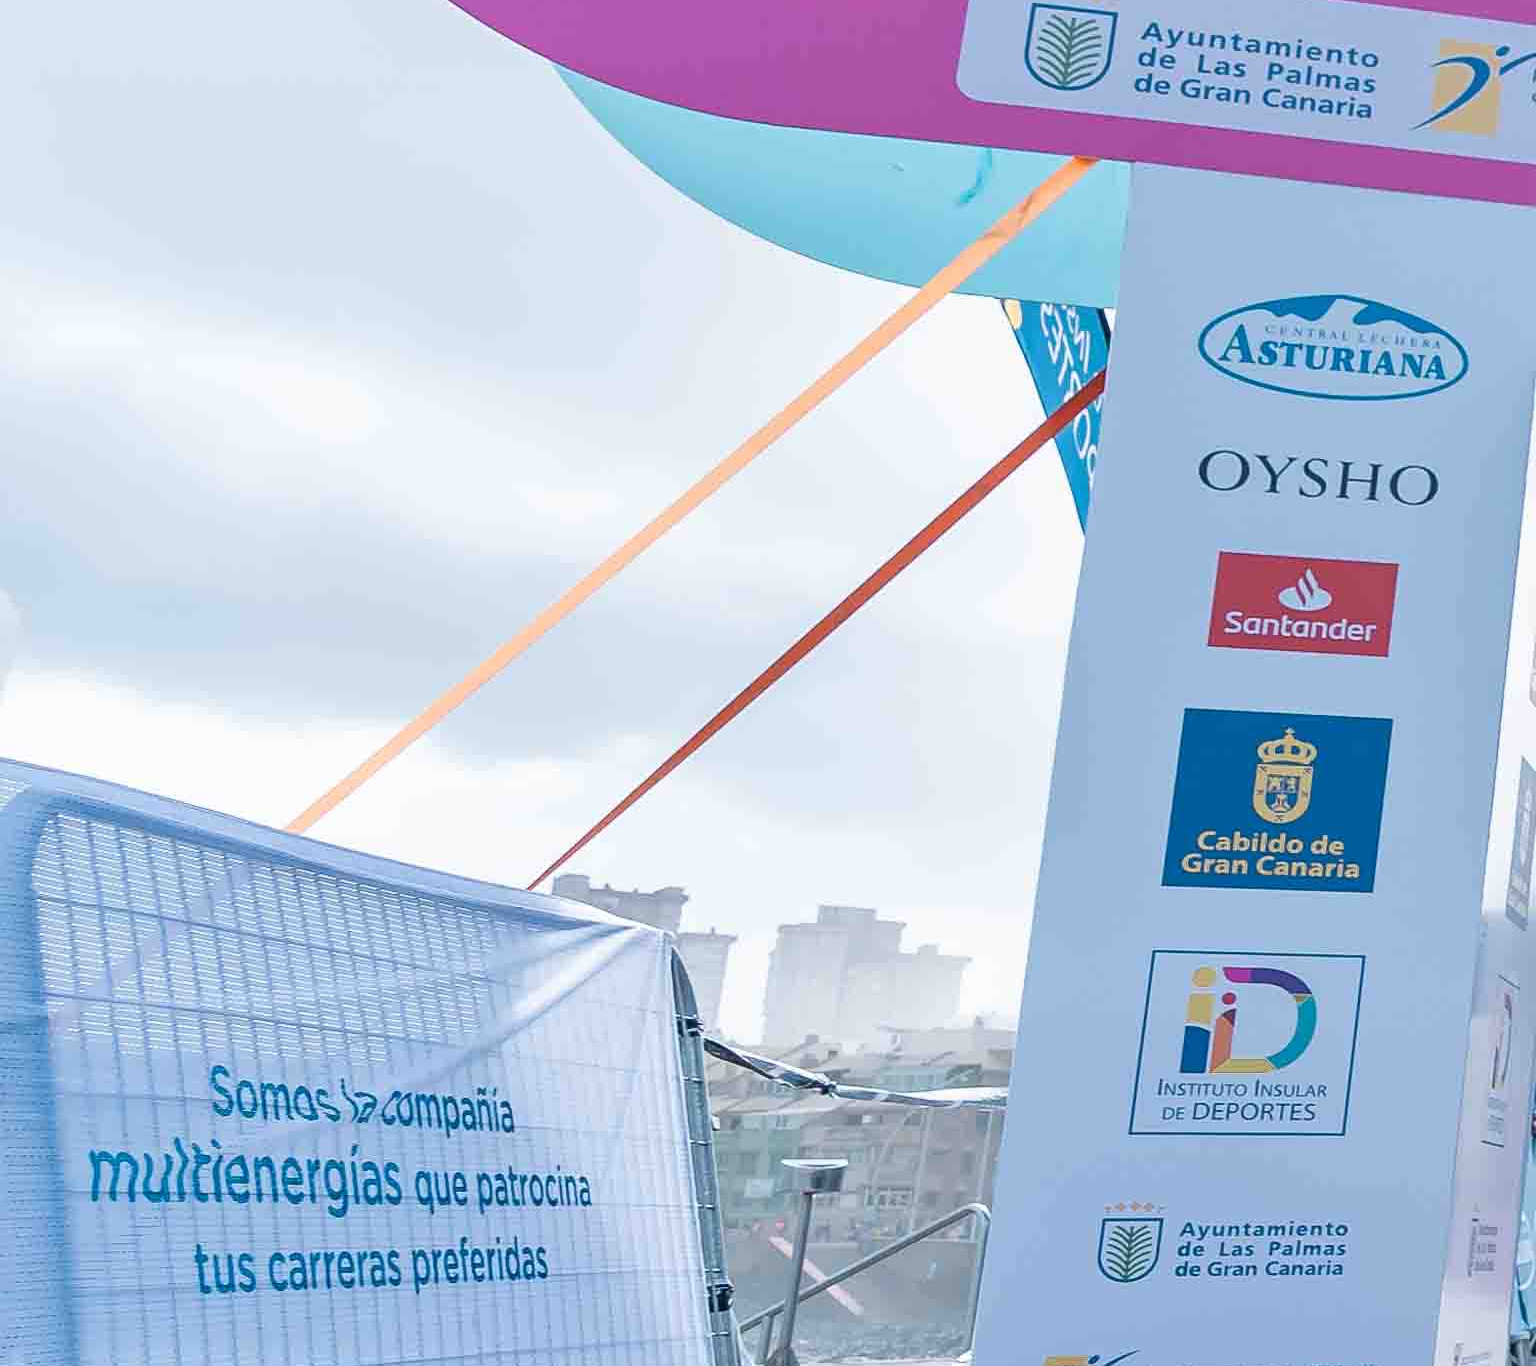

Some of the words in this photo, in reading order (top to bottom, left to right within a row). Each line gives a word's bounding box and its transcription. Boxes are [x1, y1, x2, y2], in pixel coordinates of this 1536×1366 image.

[1141, 21, 1379, 68] Ayuntamiento
[1138, 48, 1176, 70] de
[1198, 54, 1247, 78] Las
[1266, 63, 1376, 93] Palmas
[1134, 74, 1171, 96] de
[1180, 78, 1252, 106] Gran
[1262, 88, 1373, 119] Canaria
[1218, 323, 1446, 381] ASTURIANA
[1199, 449, 1439, 506] OYSHO
[1224, 610, 1377, 643] Santander
[1197, 830, 1303, 854] Cabildo
[1310, 835, 1344, 855] de
[1181, 853, 1247, 875] Gran
[1256, 854, 1360, 879] Canaria
[210, 1065, 340, 1123] Somos
[381, 1087, 515, 1139] compañía
[1157, 1079, 1248, 1098] INSTITUTO
[1254, 1079, 1328, 1098] INSULAR
[1162, 1106, 1185, 1120] DE
[1192, 1102, 1317, 1121] DEPORTES
[89, 1137, 402, 1219] multienergías
[415, 1171, 468, 1216] que
[478, 1165, 592, 1216] patrocina
[1177, 1240, 1204, 1257] de
[1219, 1241, 1254, 1257] Las
[1268, 1240, 1346, 1257] Palmas
[1179, 1220, 1348, 1240] Ayuntamiento
[194, 1243, 256, 1294] tus
[268, 1244, 402, 1292] carreras
[412, 1236, 549, 1294] preferidas
[1175, 1261, 1201, 1277] de
[1207, 1261, 1257, 1277] Gran
[1265, 1260, 1344, 1276] Canaria
